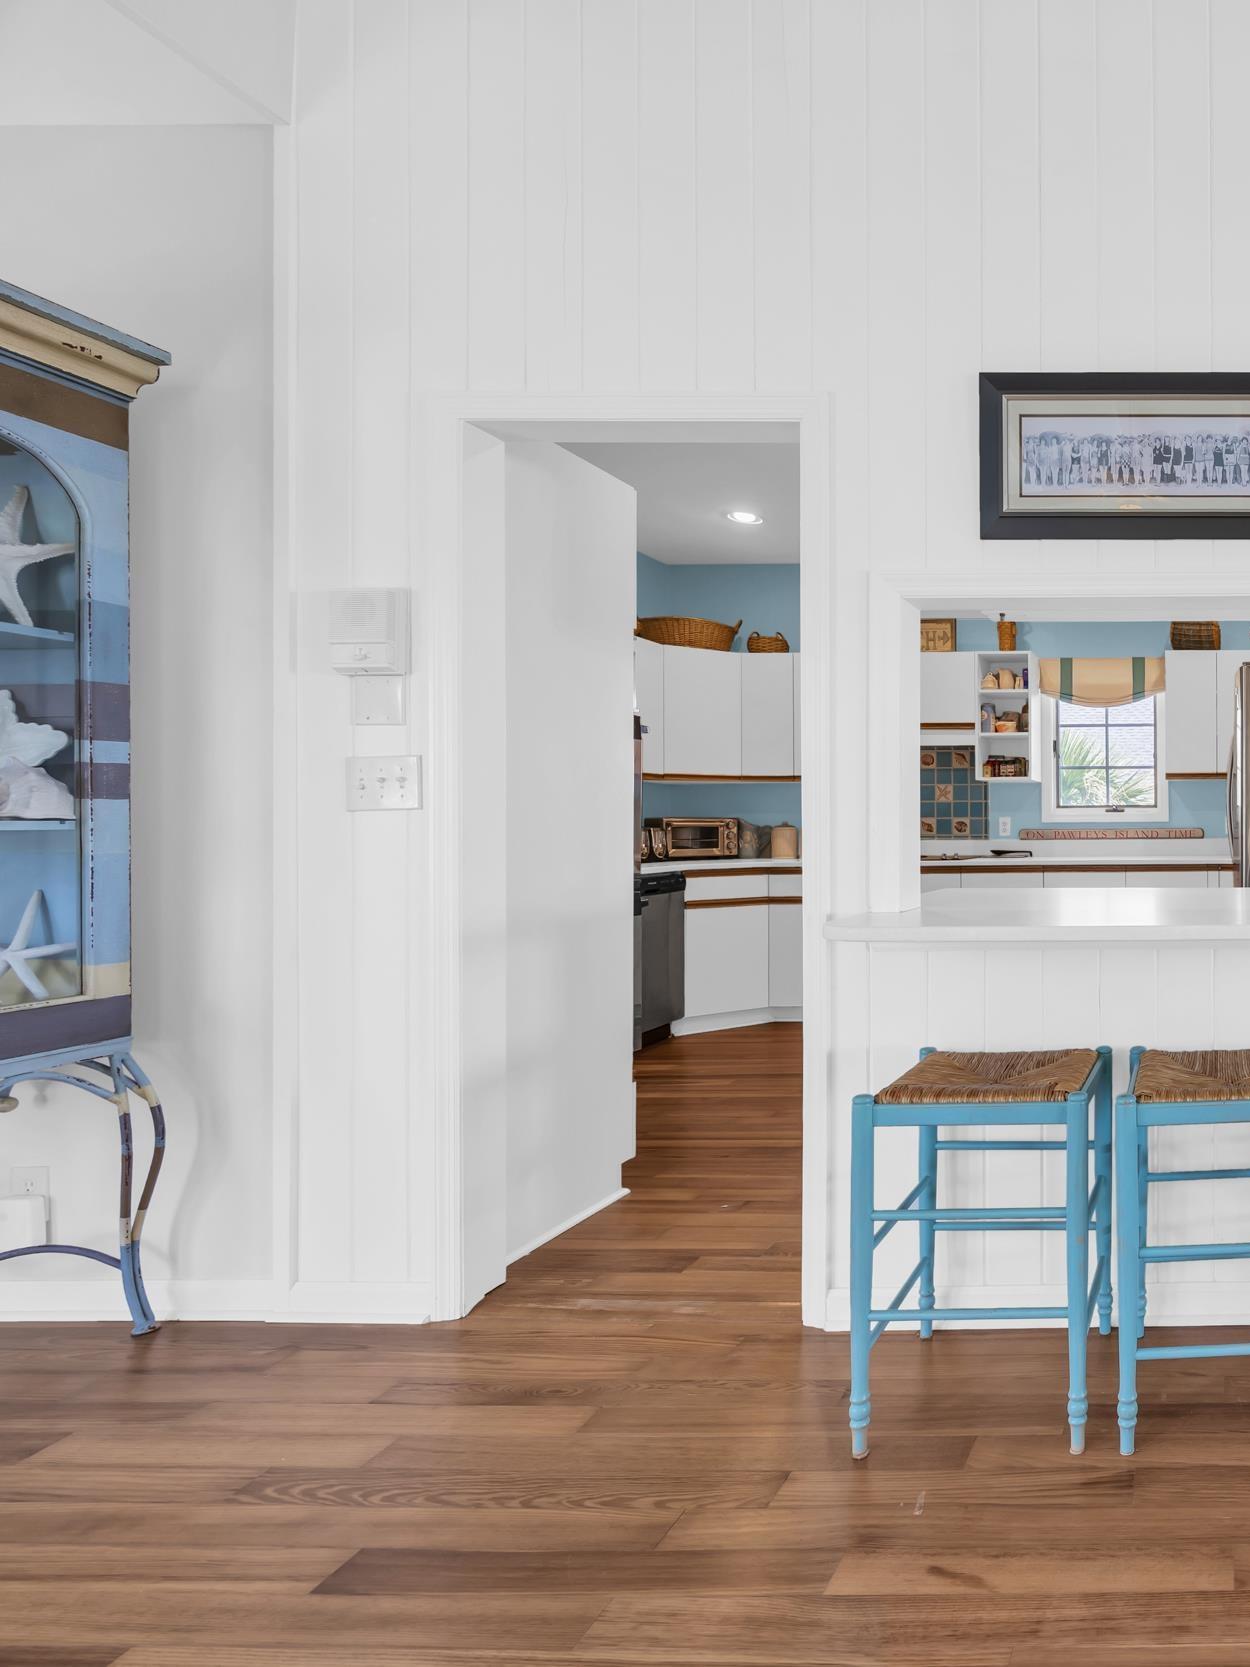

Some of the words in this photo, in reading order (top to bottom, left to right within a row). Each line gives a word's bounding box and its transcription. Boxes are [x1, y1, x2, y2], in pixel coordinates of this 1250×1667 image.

[1054, 831, 1107, 839] PAWLEYS
[1115, 830, 1159, 839] ISLAND
[1167, 830, 1196, 839] TIME
